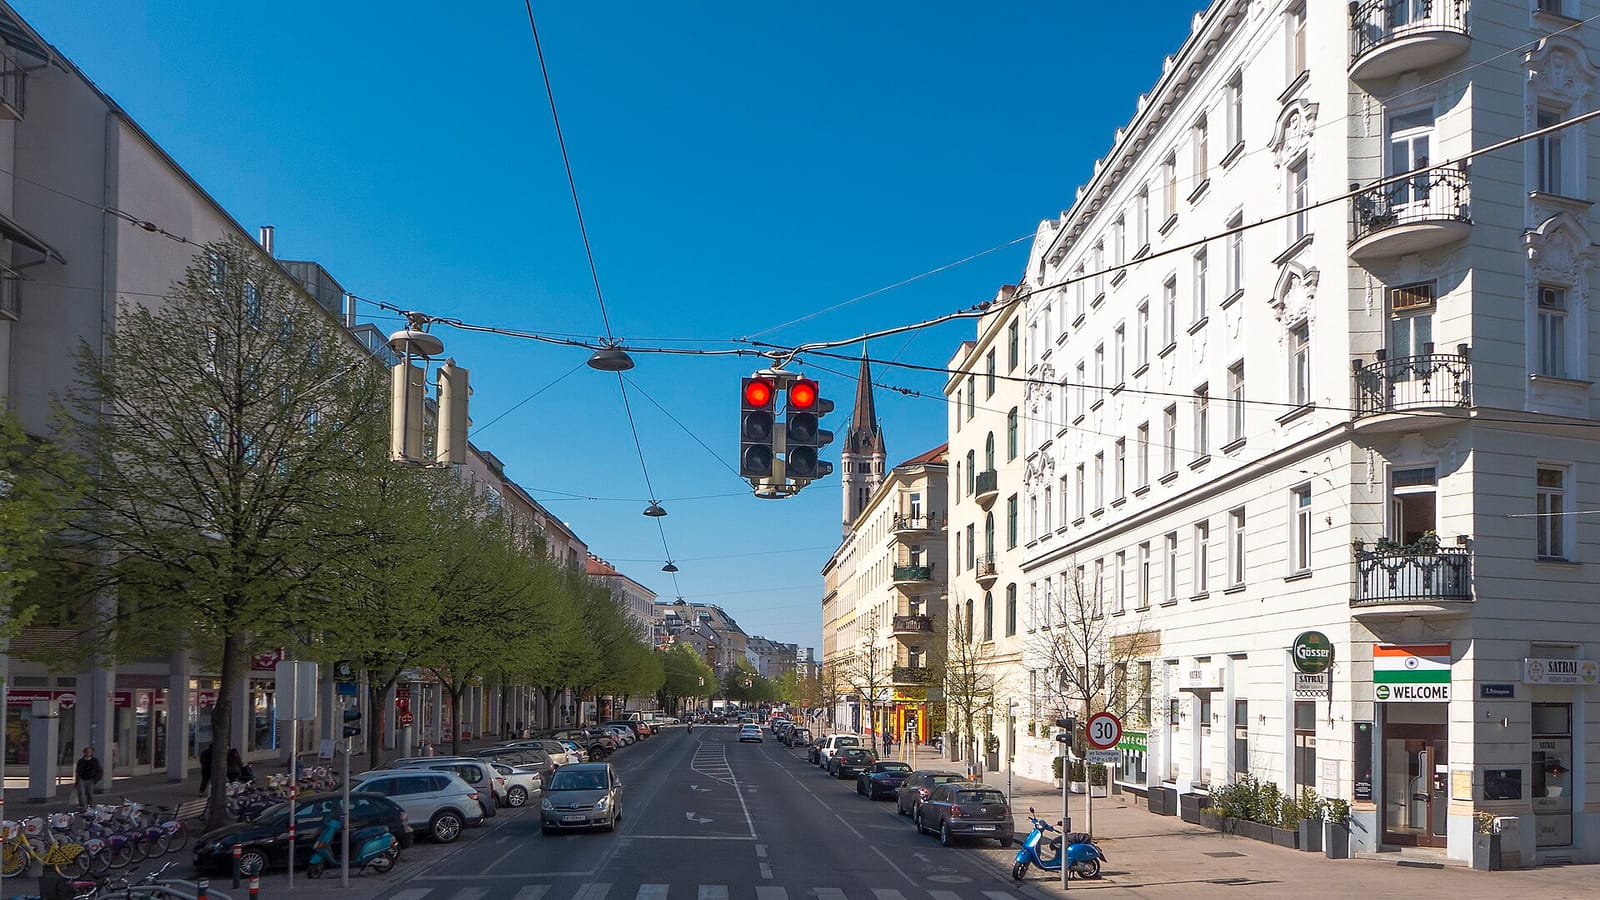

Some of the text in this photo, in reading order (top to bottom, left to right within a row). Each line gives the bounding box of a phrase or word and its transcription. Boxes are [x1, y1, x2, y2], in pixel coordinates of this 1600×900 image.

[1297, 644, 1329, 660] Gösser
[1548, 661, 1578, 675] SATRAJ
[1299, 675, 1324, 684] SATRAJ
[1393, 686, 1449, 699] WELCOME
[1095, 722, 1113, 739] 30
